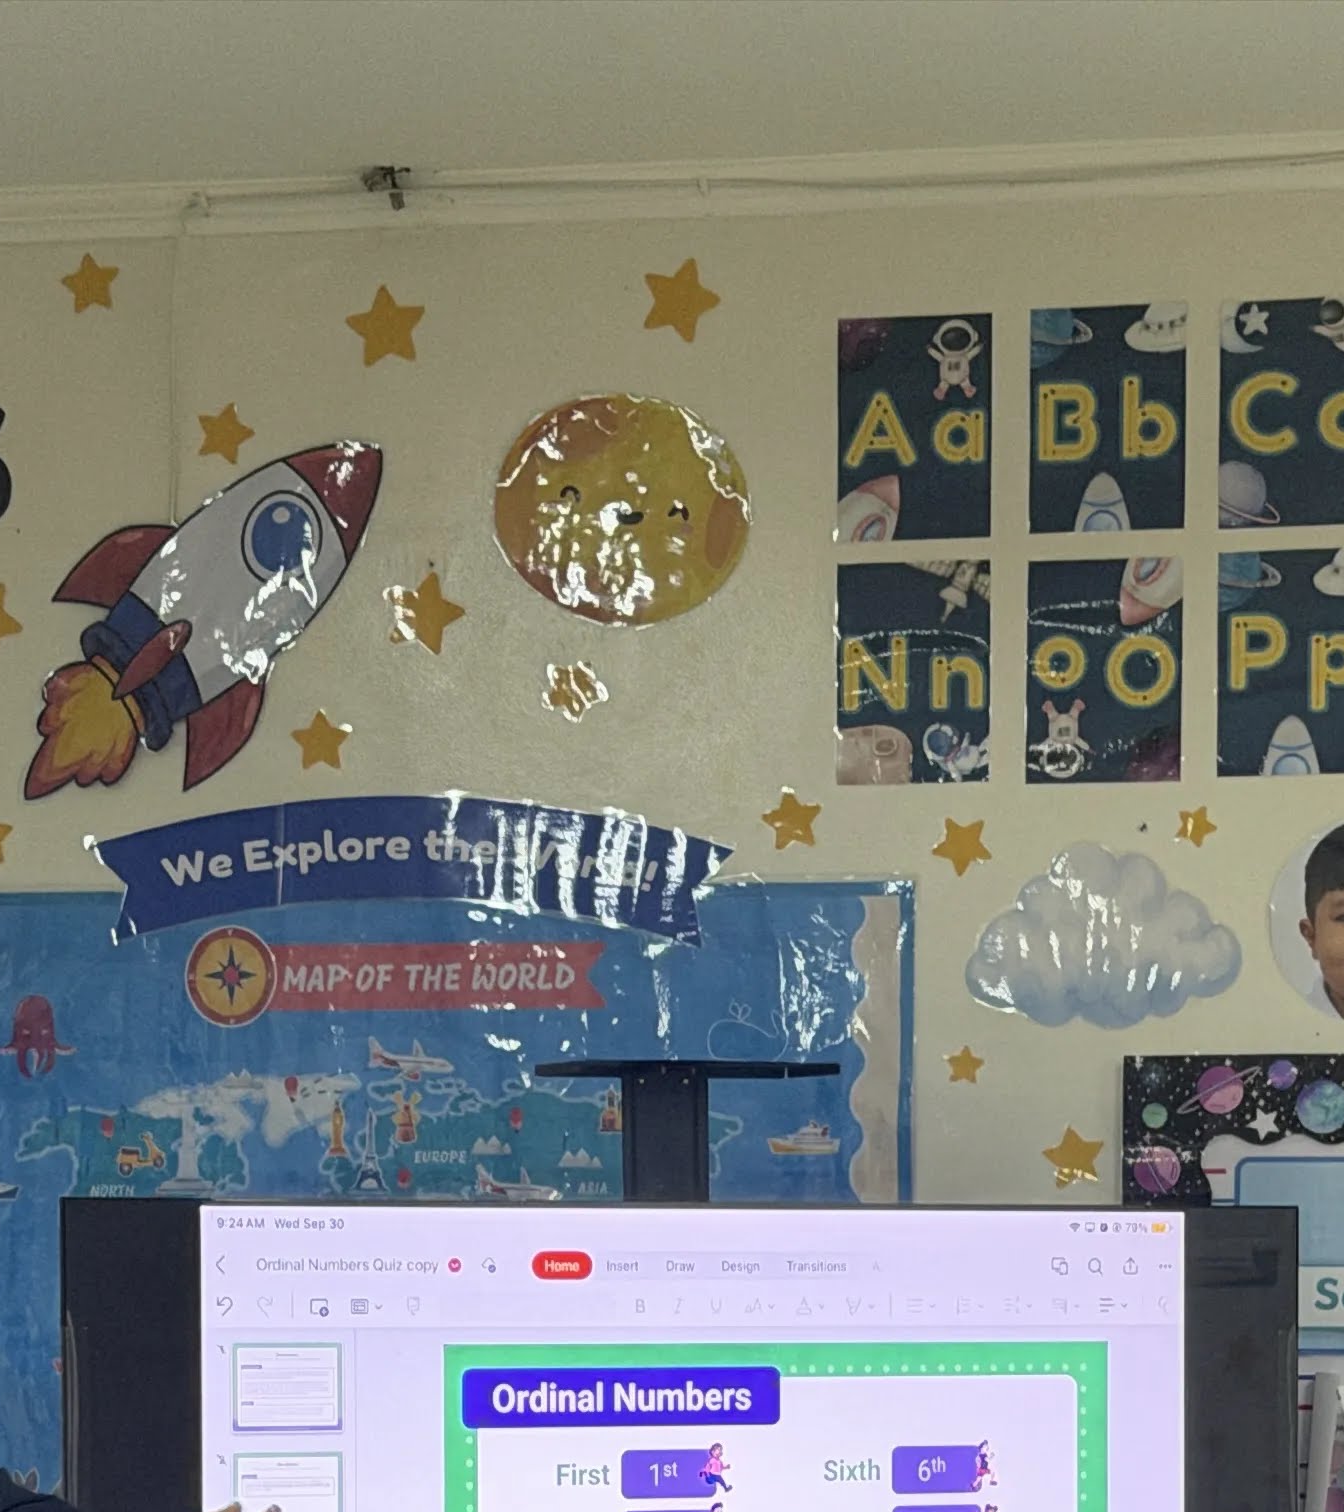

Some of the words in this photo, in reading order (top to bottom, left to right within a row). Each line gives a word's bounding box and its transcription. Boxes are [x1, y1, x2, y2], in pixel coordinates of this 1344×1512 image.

[846, 391, 984, 466] Aa
[1038, 376, 1177, 460] Bb
[843, 636, 984, 711] Nn
[161, 850, 232, 888] We
[245, 830, 411, 881] Explore
[423, 827, 494, 868] the
[283, 965, 348, 993] MAP
[355, 965, 395, 993] OF
[405, 964, 462, 991] THE
[471, 963, 575, 991] WORLD
[414, 1150, 467, 1165] EUROPE
[90, 1184, 135, 1199] NORTH
[578, 1181, 609, 1195] ASIA
[216, 1217, 244, 1230] 9:24
[245, 1217, 266, 1230] AM
[274, 1217, 300, 1229] Wed
[303, 1217, 327, 1232] Sep
[329, 1217, 345, 1230] 30
[256, 1257, 305, 1273] Ordinal
[308, 1257, 370, 1273] Numbers
[372, 1257, 403, 1274] Quiz
[406, 1259, 439, 1276] copy
[544, 1258, 580, 1274] Home
[606, 1259, 638, 1273] Insert
[666, 1259, 695, 1273] Draw
[721, 1259, 760, 1276] Design
[786, 1259, 847, 1273] Transitions
[492, 1381, 604, 1413] Ordinal
[613, 1380, 753, 1412] Numbers
[556, 1463, 610, 1485] First
[649, 1461, 678, 1486] 1st
[823, 1458, 881, 1481] Sixth
[917, 1456, 946, 1482] 6th
